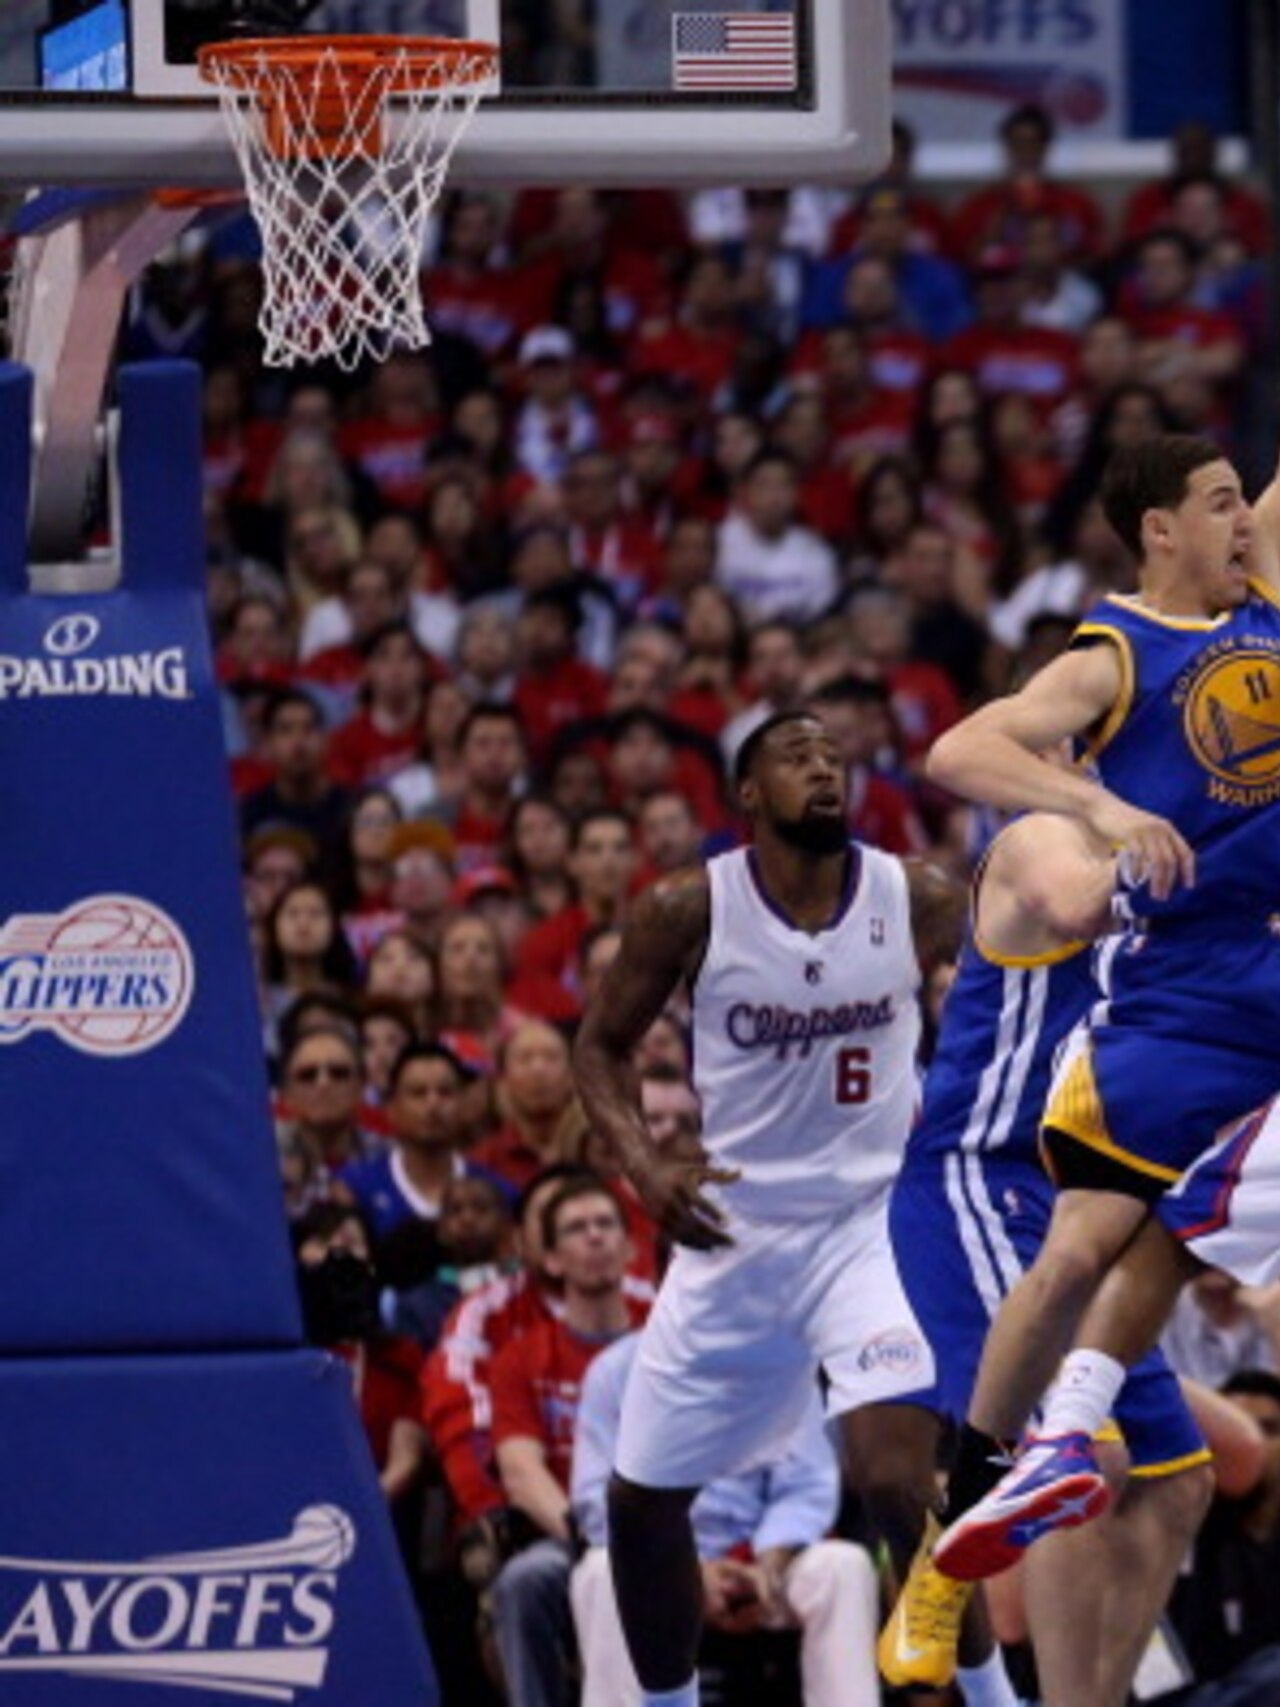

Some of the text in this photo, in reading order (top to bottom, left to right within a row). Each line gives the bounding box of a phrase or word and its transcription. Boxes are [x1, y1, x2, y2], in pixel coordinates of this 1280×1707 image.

[1244, 667, 1273, 705] 11
[726, 994, 896, 1060] Clippers
[835, 1046, 872, 1105] 6
[0, 1571, 338, 1652] AYOFFS
